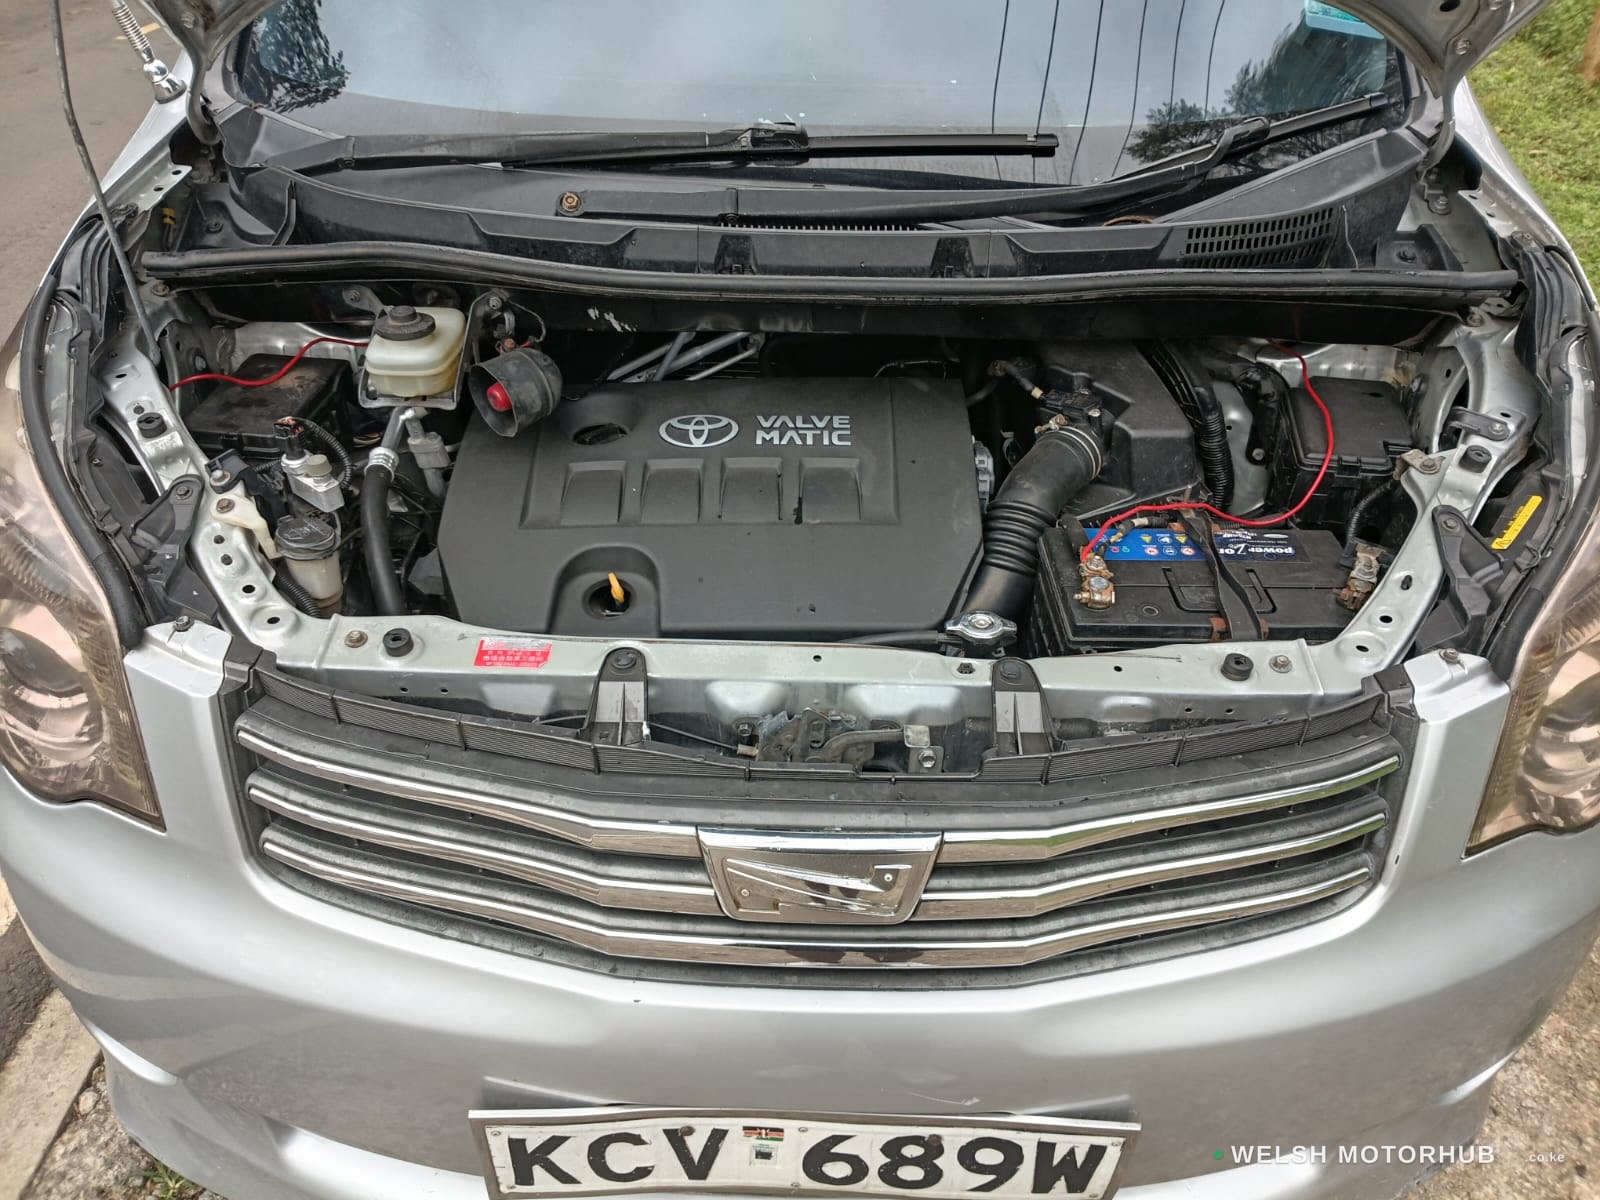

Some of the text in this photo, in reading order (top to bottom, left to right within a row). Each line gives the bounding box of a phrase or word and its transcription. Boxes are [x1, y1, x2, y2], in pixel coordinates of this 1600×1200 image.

[756, 415, 850, 428] VALVE
[756, 430, 852, 446] MATIC
[508, 1127, 1108, 1194] KCV 689W
